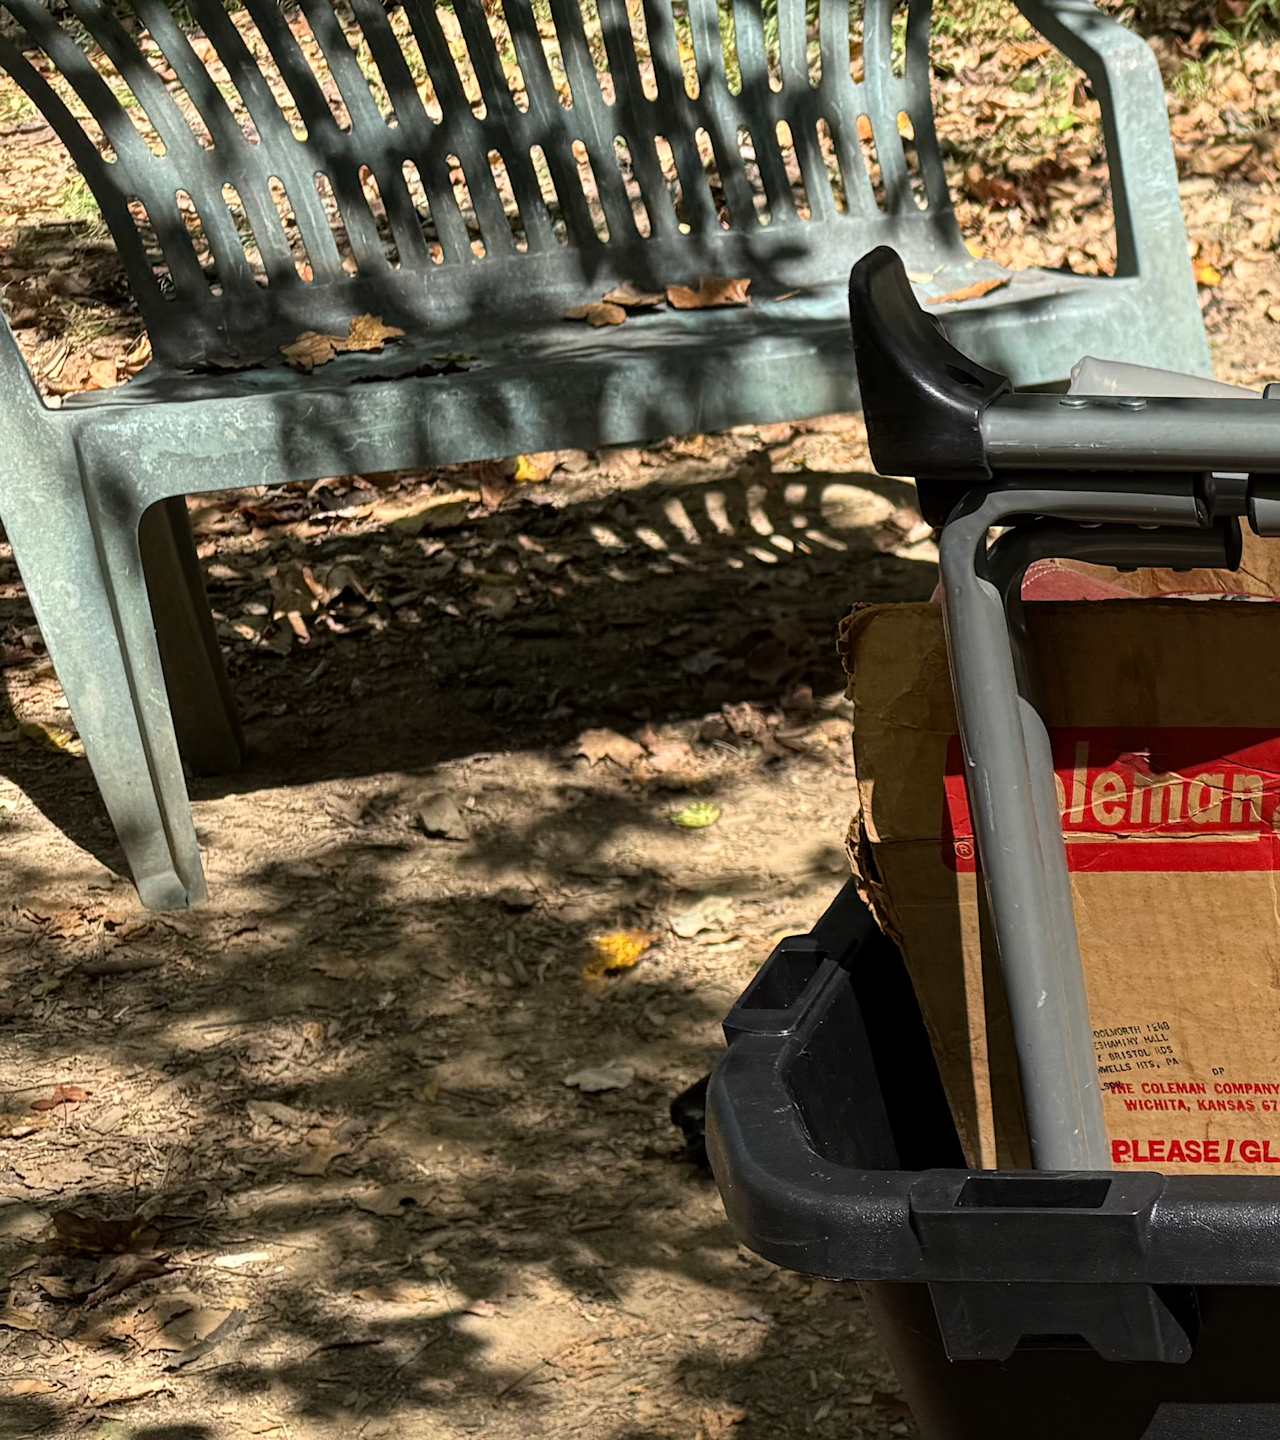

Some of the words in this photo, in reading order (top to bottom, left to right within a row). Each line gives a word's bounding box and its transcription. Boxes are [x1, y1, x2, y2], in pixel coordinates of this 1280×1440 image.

[1054, 741, 1264, 825] leman
[1141, 1082, 1207, 1095] COLEMAN
[1213, 1082, 1280, 1095] COMPANY
[1124, 1099, 1191, 1113] WICHITA,
[1198, 1099, 1256, 1112] KANSAS
